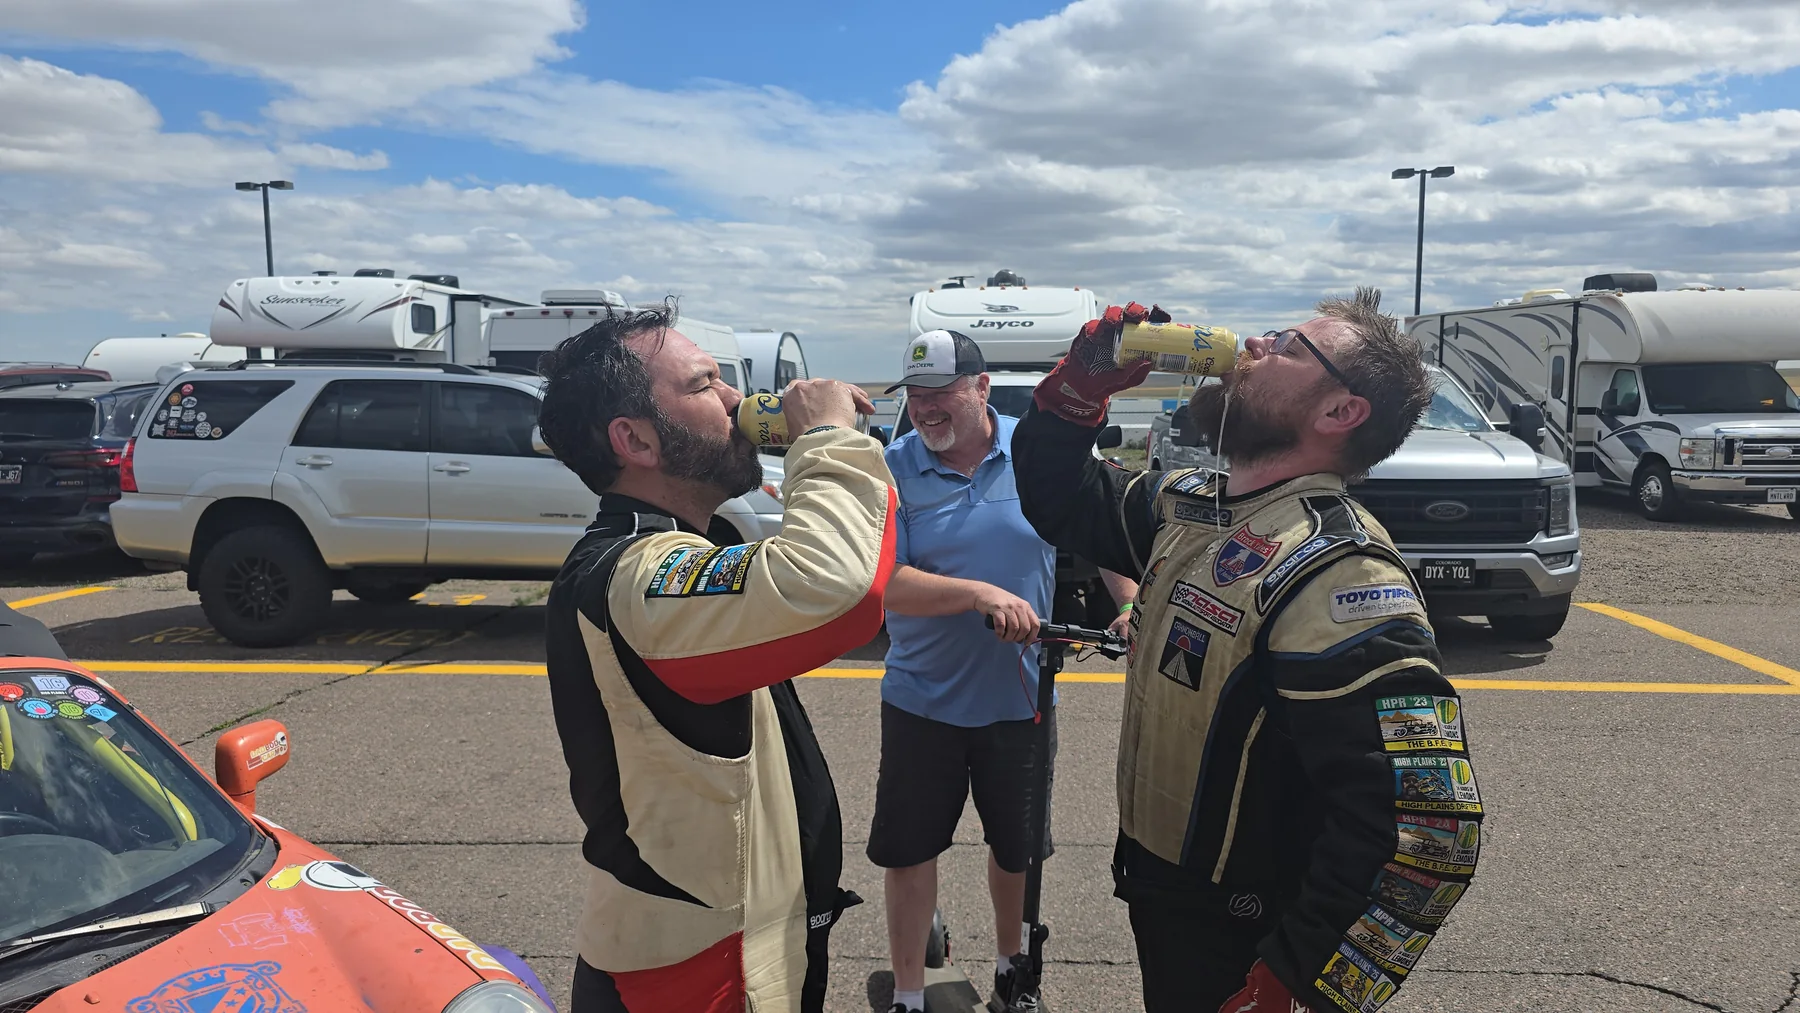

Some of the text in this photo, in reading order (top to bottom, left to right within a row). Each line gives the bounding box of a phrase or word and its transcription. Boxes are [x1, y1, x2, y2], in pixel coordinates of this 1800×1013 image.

[260, 294, 346, 305] Sunseeker
[969, 319, 1034, 330] Jayco
[1175, 503, 1230, 523] sparco
[1265, 538, 1329, 588] sparco
[1335, 588, 1416, 606] TOYO TIRE
[1185, 590, 1239, 624] nasa
[1348, 602, 1377, 614] driven
[40, 678, 66, 689] 16
[1381, 696, 1428, 709] HPR '23
[1406, 741, 1426, 749] THE
[1394, 757, 1412, 767] HIGH
[1413, 757, 1437, 767] PLAINS
[1424, 803, 1455, 811] PLAINS
[1402, 814, 1428, 827] HPR
[1414, 860, 1429, 868] THE
[1452, 853, 1474, 863] LEMONS
[1371, 907, 1411, 936] HPR '25
[1339, 942, 1354, 959] HIGH
[1352, 952, 1373, 974] PLAINS
[1319, 983, 1337, 1001] HIGH
